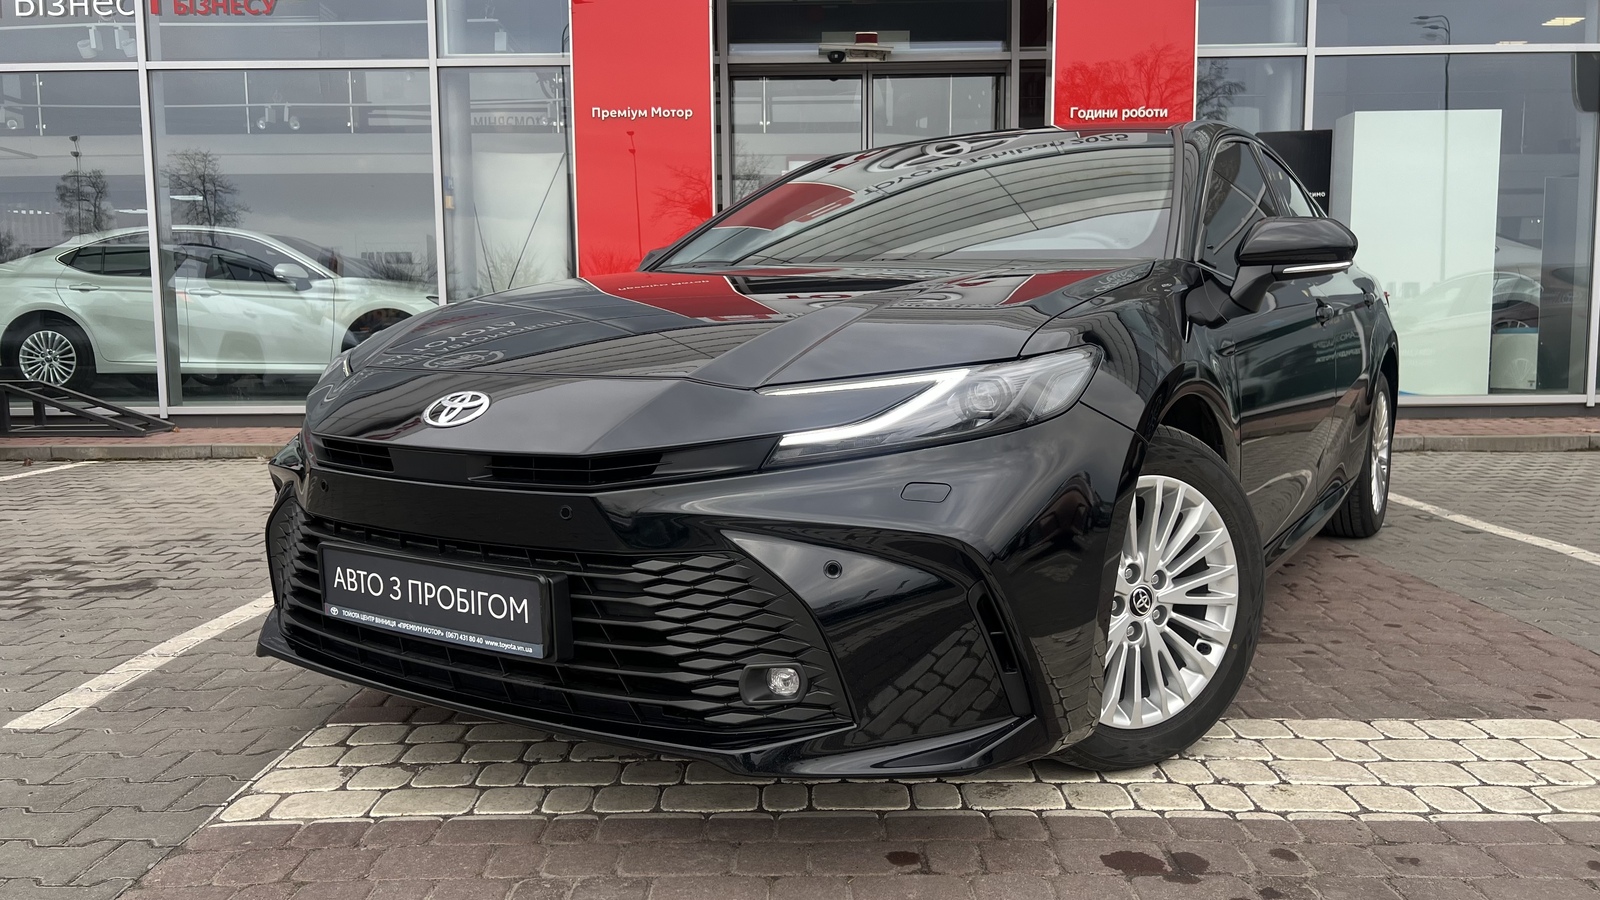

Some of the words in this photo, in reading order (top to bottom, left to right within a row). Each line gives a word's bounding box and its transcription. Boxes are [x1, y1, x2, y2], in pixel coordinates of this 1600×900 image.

[591, 107, 648, 120] Преміум
[651, 107, 693, 120] Мотор
[1070, 107, 1118, 120] Години
[1122, 106, 1168, 120] роботи
[334, 566, 384, 597] АВТО
[389, 577, 402, 600] З
[408, 580, 529, 624] ПРОБІГОМ
[342, 609, 360, 619] ТОЙОТА
[360, 613, 375, 623] ЦЕНТР
[445, 631, 459, 640] (067)
[468, 635, 476, 643] 80
[484, 639, 533, 653] www.toyota.vn.ua
